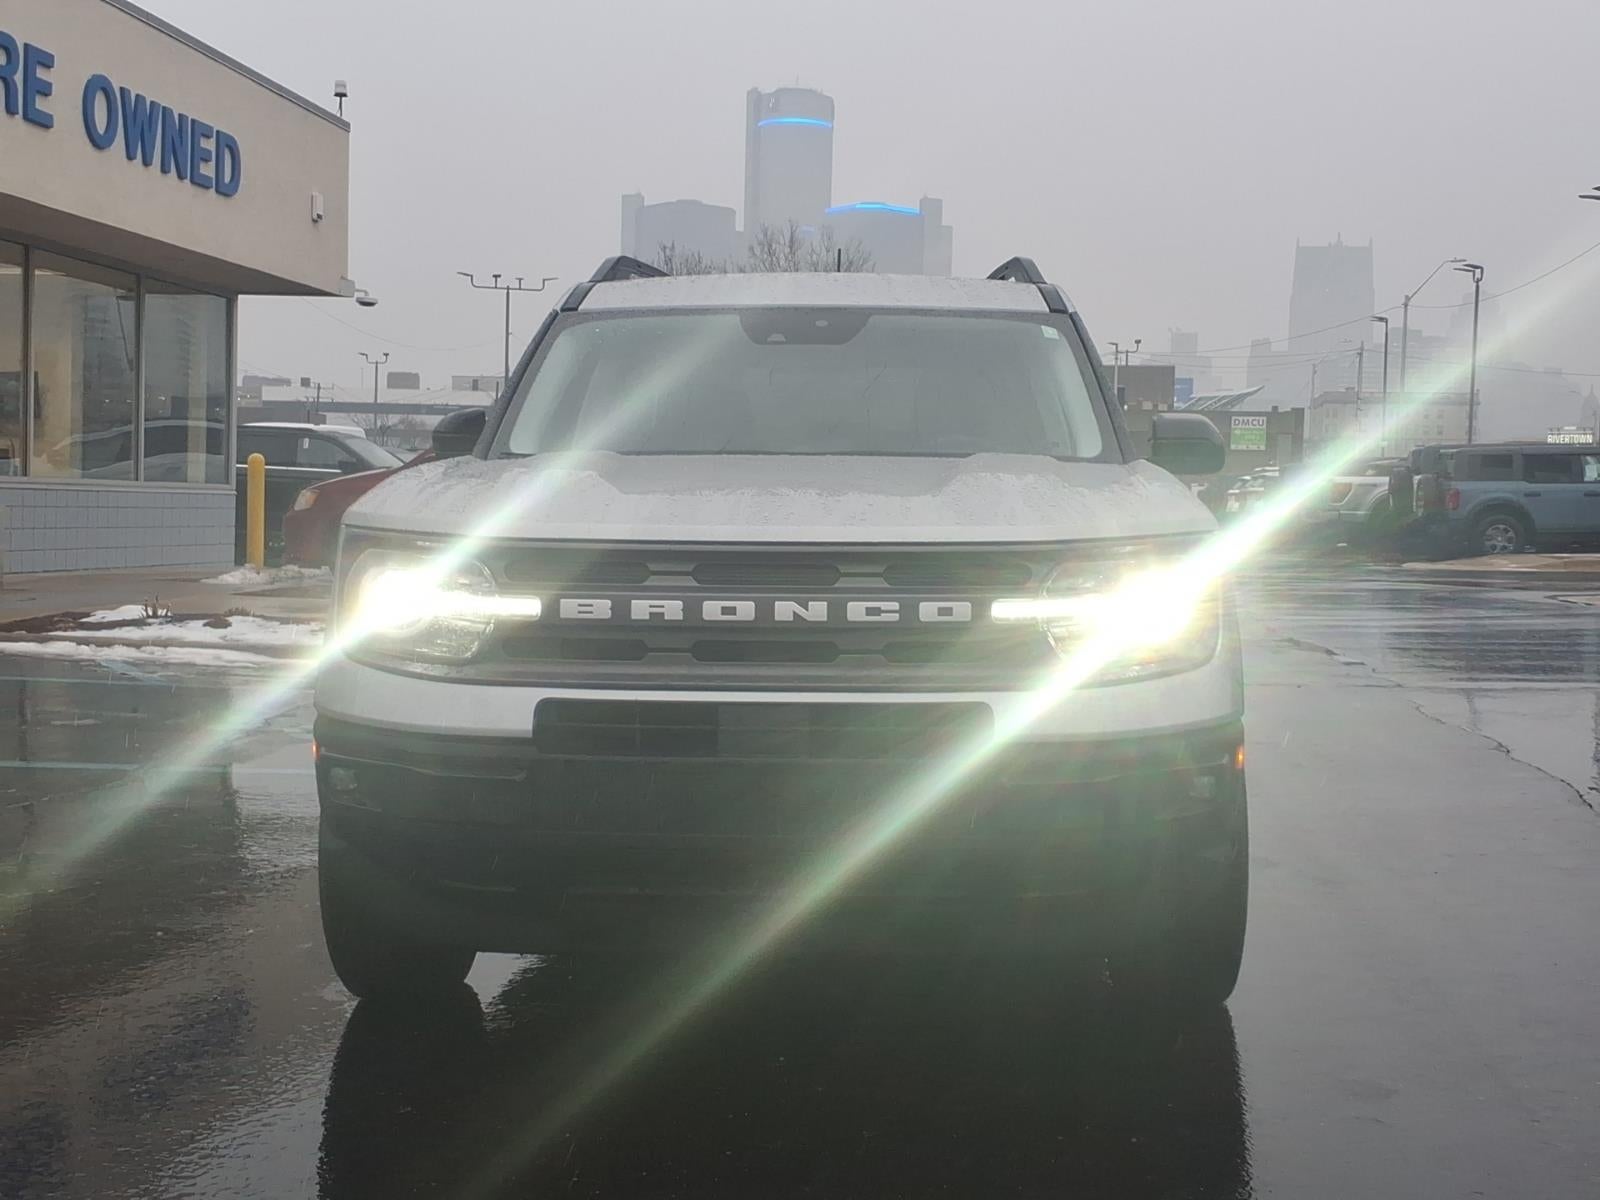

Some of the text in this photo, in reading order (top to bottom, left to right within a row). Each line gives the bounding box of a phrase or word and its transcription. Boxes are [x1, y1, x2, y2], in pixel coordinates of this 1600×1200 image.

[82, 74, 242, 197] OWNED
[1232, 418, 1265, 427] DMCU
[1547, 433, 1593, 444] RIVERTOWN
[559, 598, 972, 622] BRONCO
